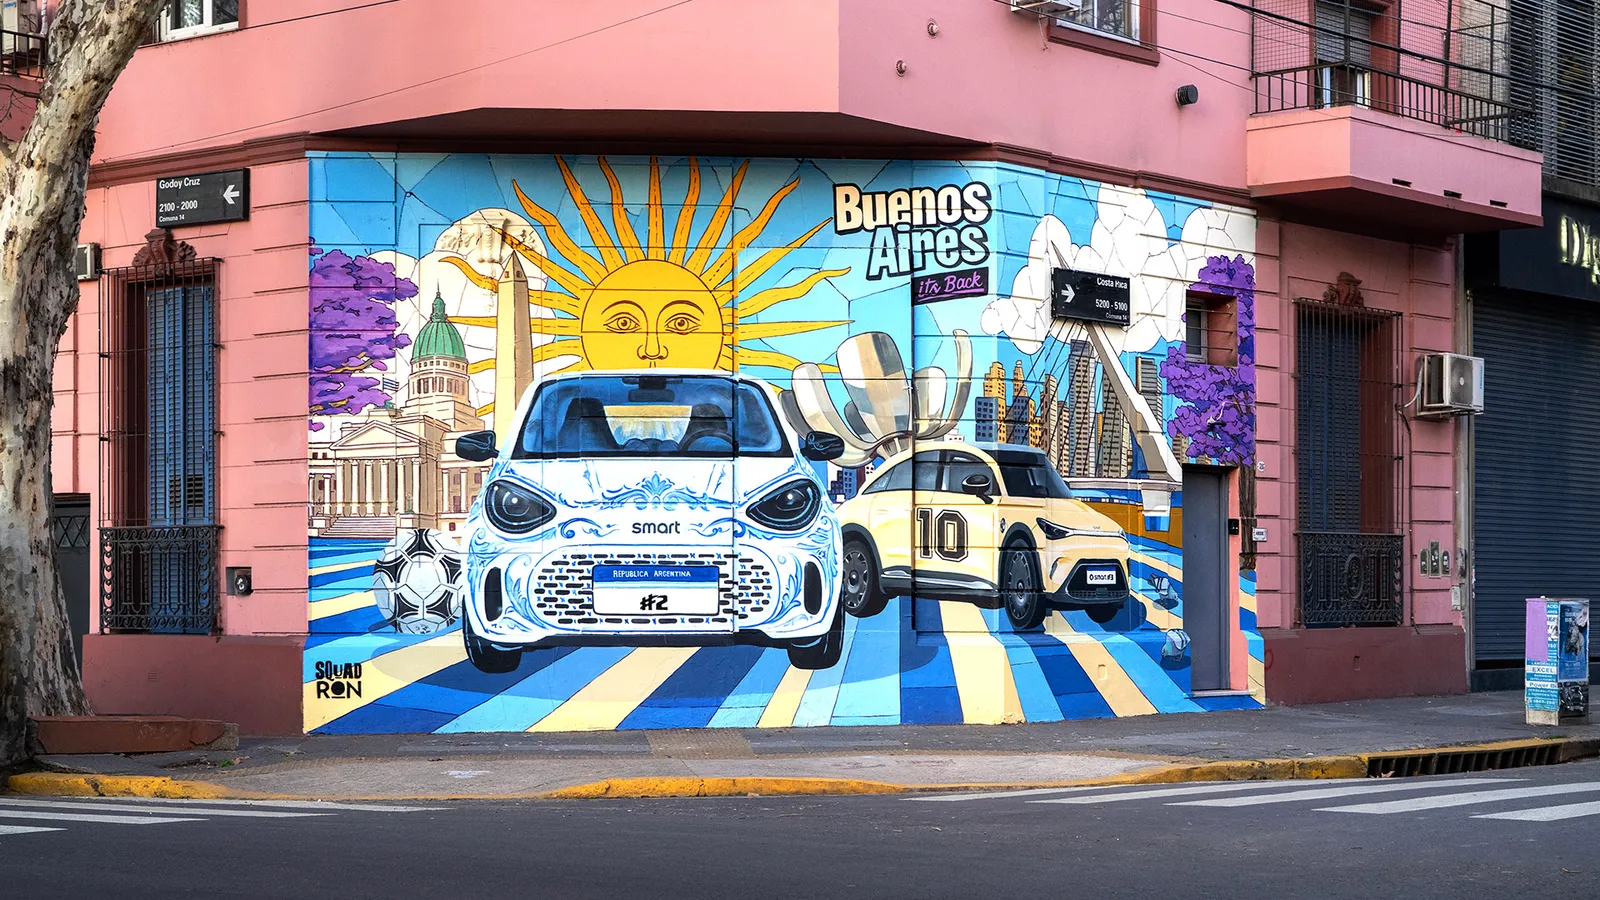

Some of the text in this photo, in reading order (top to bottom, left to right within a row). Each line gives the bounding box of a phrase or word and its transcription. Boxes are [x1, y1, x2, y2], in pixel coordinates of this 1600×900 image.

[159, 177, 200, 189] Godoy Cruz
[159, 202, 175, 212] 2100
[180, 200, 198, 210] 2000
[833, 181, 992, 236] Buenos
[866, 221, 990, 281] Aires
[944, 271, 984, 292] Back
[1096, 277, 1114, 287] Costa
[1095, 299, 1110, 309] 5200
[1114, 301, 1128, 311] 5100
[1105, 312, 1122, 320] Comuna
[631, 521, 681, 534] smart
[916, 507, 969, 562] 10
[612, 569, 649, 578] REPUBLICA
[640, 594, 668, 611] #2
[315, 660, 362, 681] SQUAD
[316, 680, 362, 699] RON
